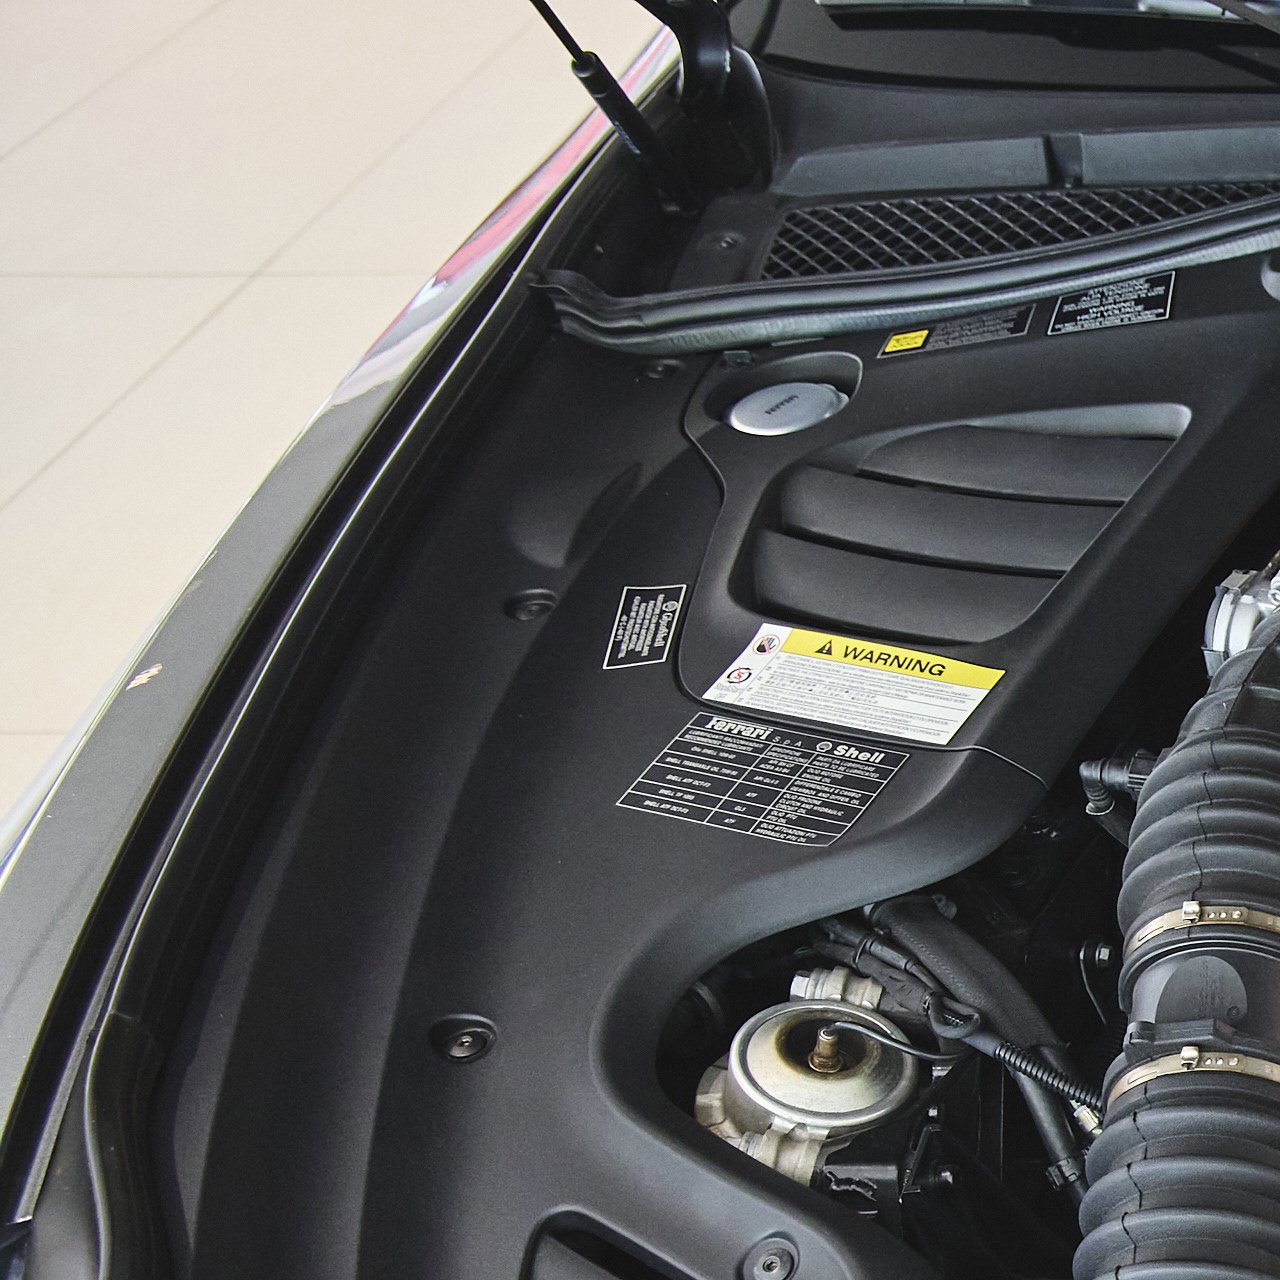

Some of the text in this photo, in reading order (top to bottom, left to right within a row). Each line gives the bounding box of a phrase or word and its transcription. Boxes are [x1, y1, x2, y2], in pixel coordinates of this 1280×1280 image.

[842, 645, 947, 677] WARNING
[703, 716, 774, 739] Ferrari
[831, 744, 886, 763] Shell
